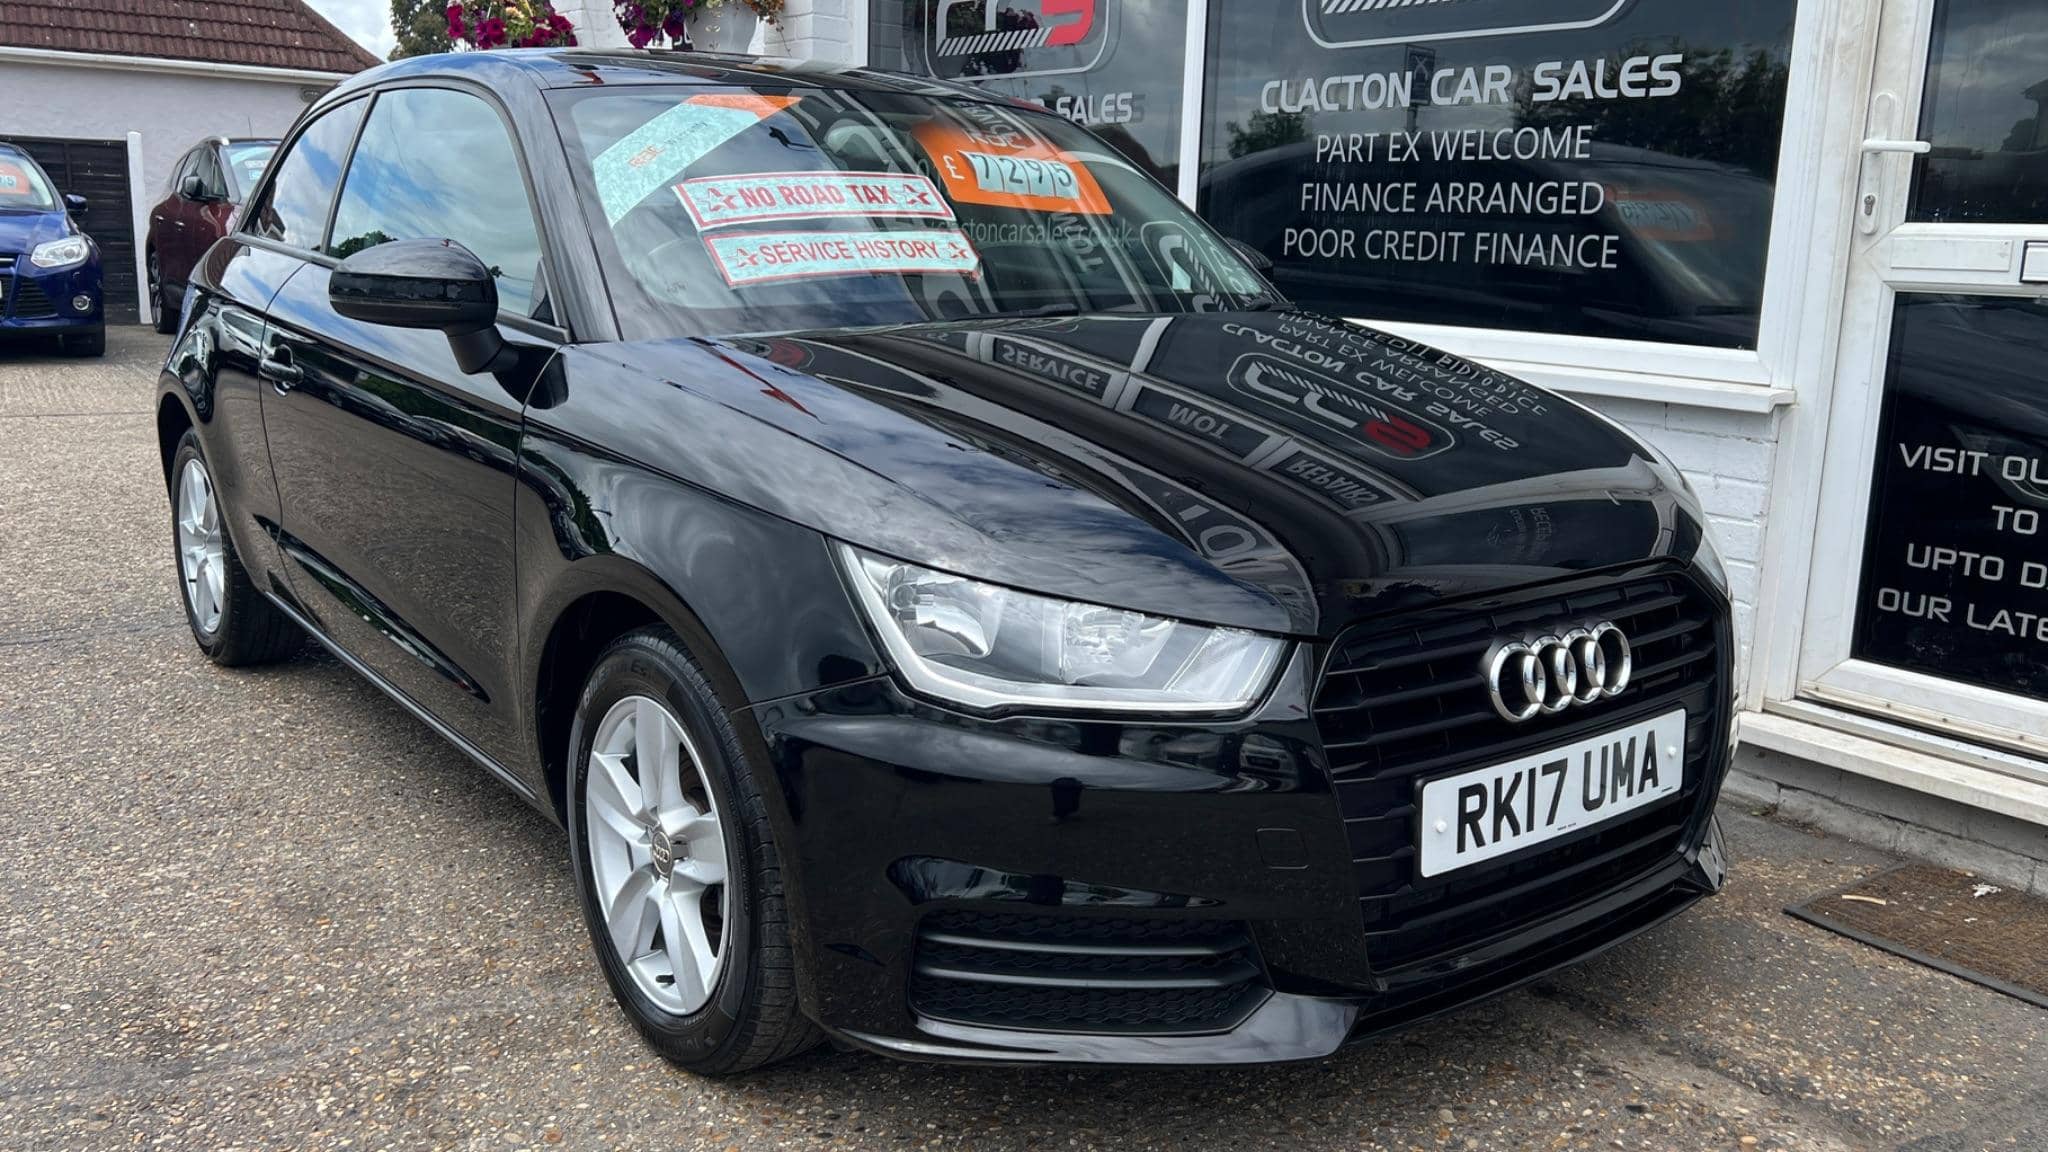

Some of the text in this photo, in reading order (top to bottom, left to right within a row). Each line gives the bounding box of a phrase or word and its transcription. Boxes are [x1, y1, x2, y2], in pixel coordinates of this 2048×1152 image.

[1262, 54, 1683, 114] CLACTON CAR SALES
[1056, 91, 1133, 125] SALES
[1316, 125, 1592, 163] PART EX WELCOME
[969, 153, 1073, 188] 7295
[738, 184, 897, 208] NO ROAD TAX
[1301, 181, 1604, 215] FINANCE ARRANGED
[760, 239, 939, 264] SERVICE HISTORY
[1284, 228, 1619, 269] POOR CREDIT FINANCE
[1900, 443, 1989, 476] VISIT
[1992, 505, 2039, 535] TO
[1907, 544, 2048, 589] UPTO D
[1878, 588, 1952, 623] OUR
[1457, 730, 1659, 854] RK17 UMA
